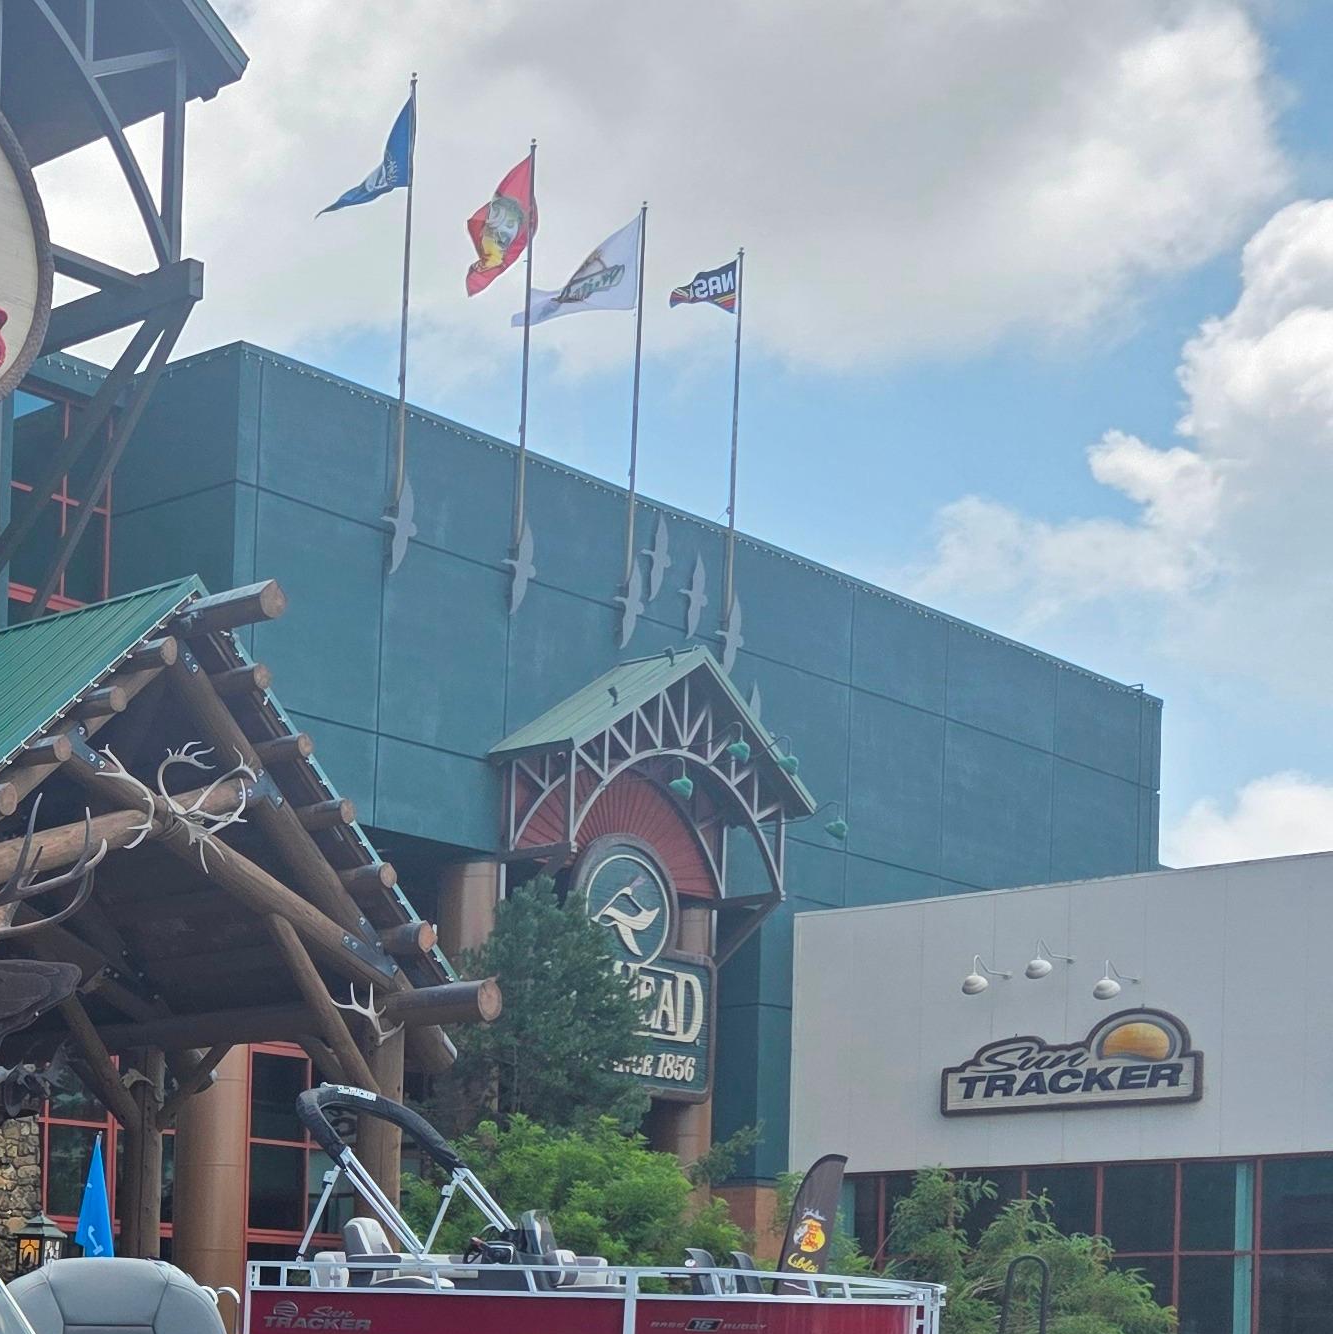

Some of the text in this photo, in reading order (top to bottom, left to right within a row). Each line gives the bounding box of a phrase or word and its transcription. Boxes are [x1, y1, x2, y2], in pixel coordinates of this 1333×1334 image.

[655, 1053, 696, 1082] 1856
[970, 1046, 1090, 1073] Sun
[958, 1063, 1183, 1100] TRACKER
[263, 1315, 372, 1330] TRACKER
